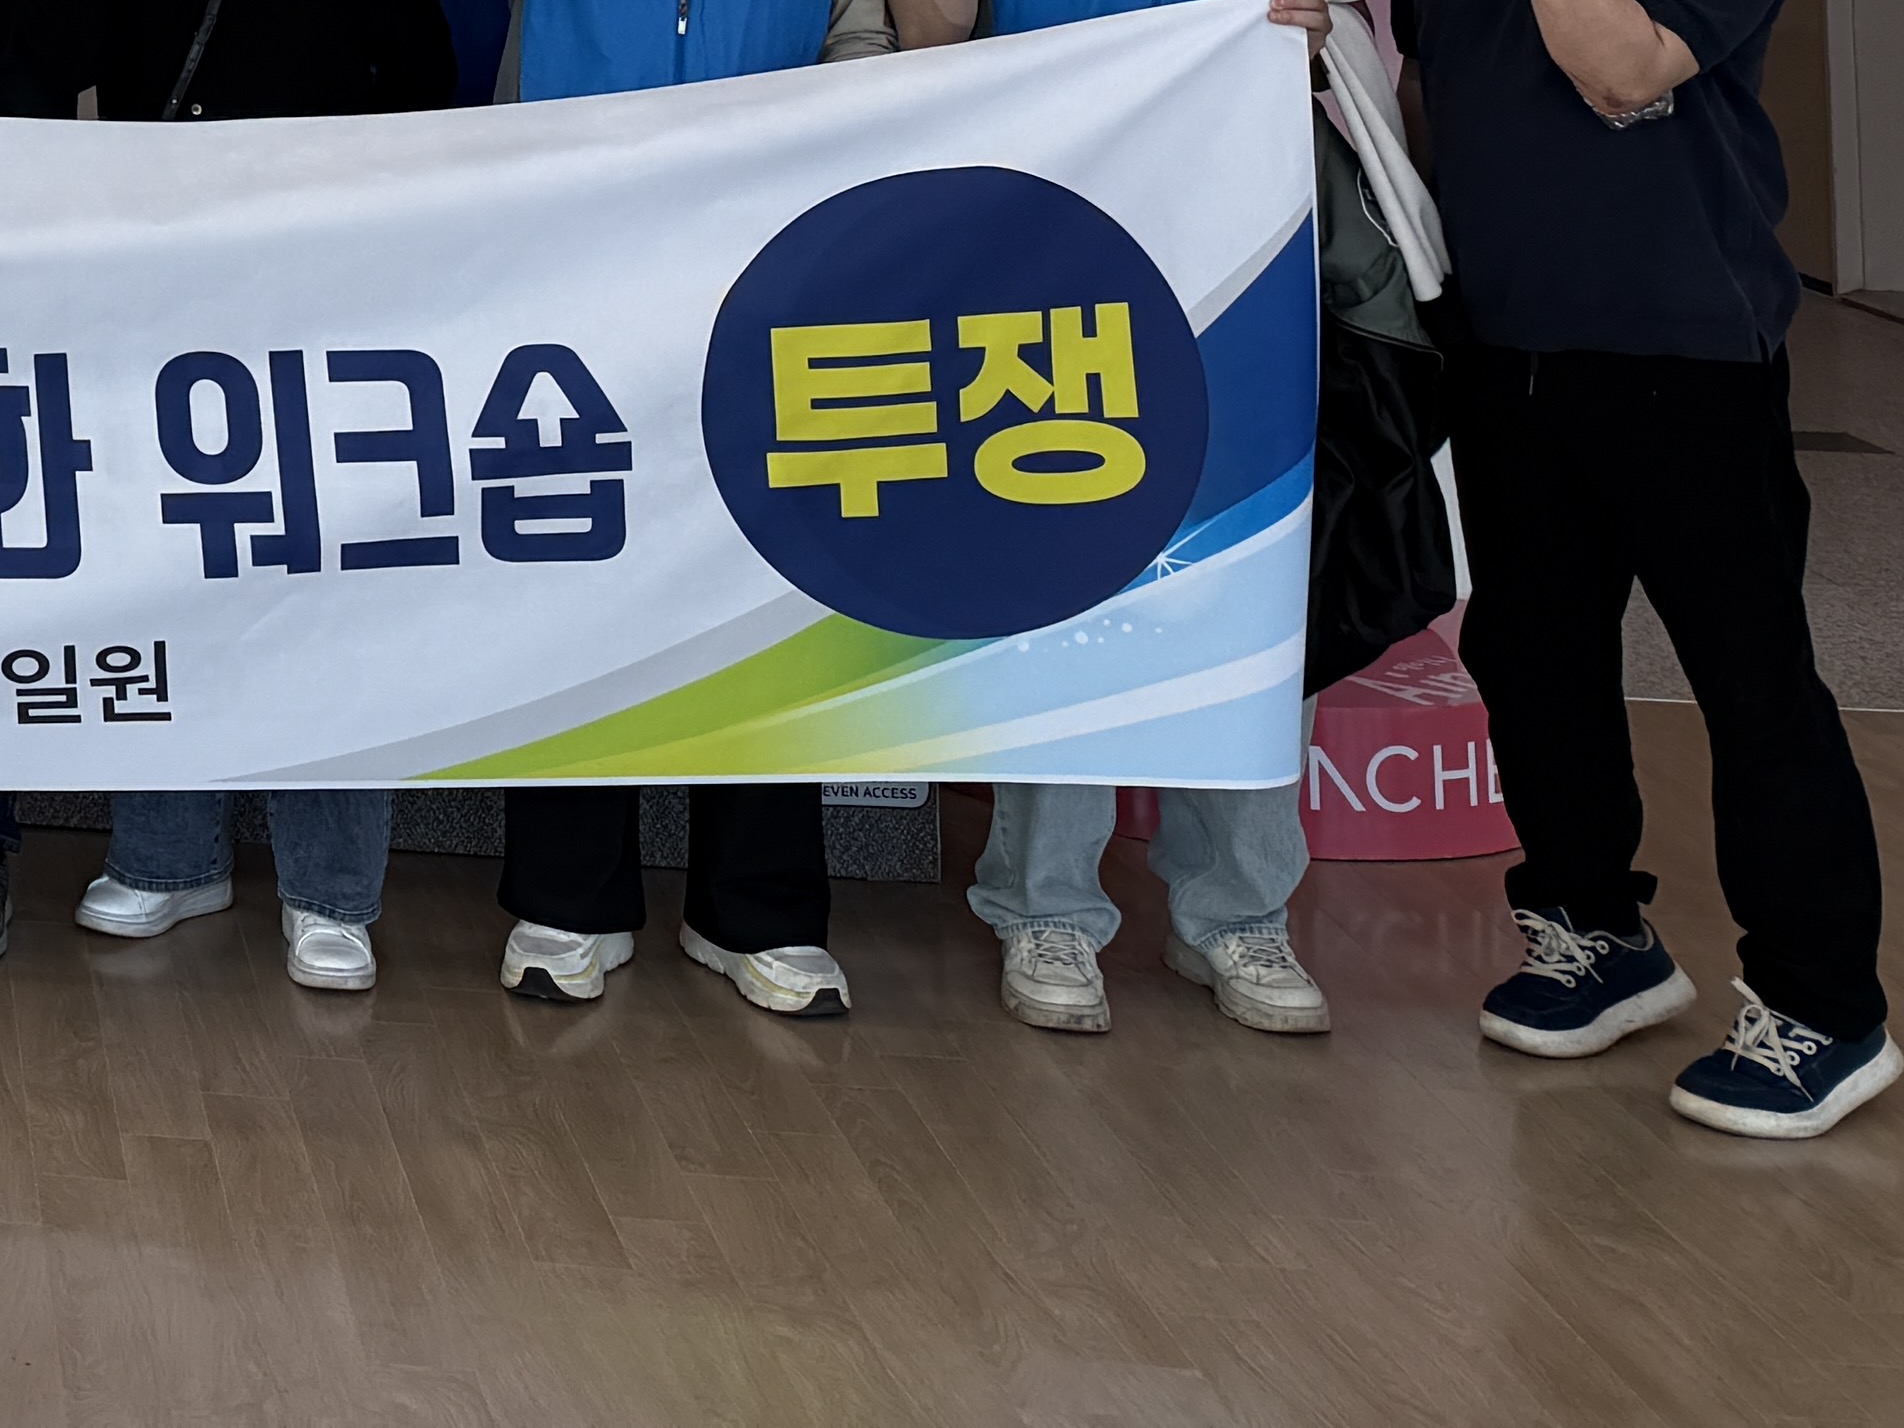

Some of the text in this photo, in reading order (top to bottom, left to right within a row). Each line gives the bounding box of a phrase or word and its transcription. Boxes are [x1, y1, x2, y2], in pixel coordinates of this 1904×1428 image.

[155, 343, 633, 580] 워크숍
[768, 304, 1145, 516] 투쟁
[0, 639, 173, 725] 일원
[863, 786, 918, 800] ACCESS
